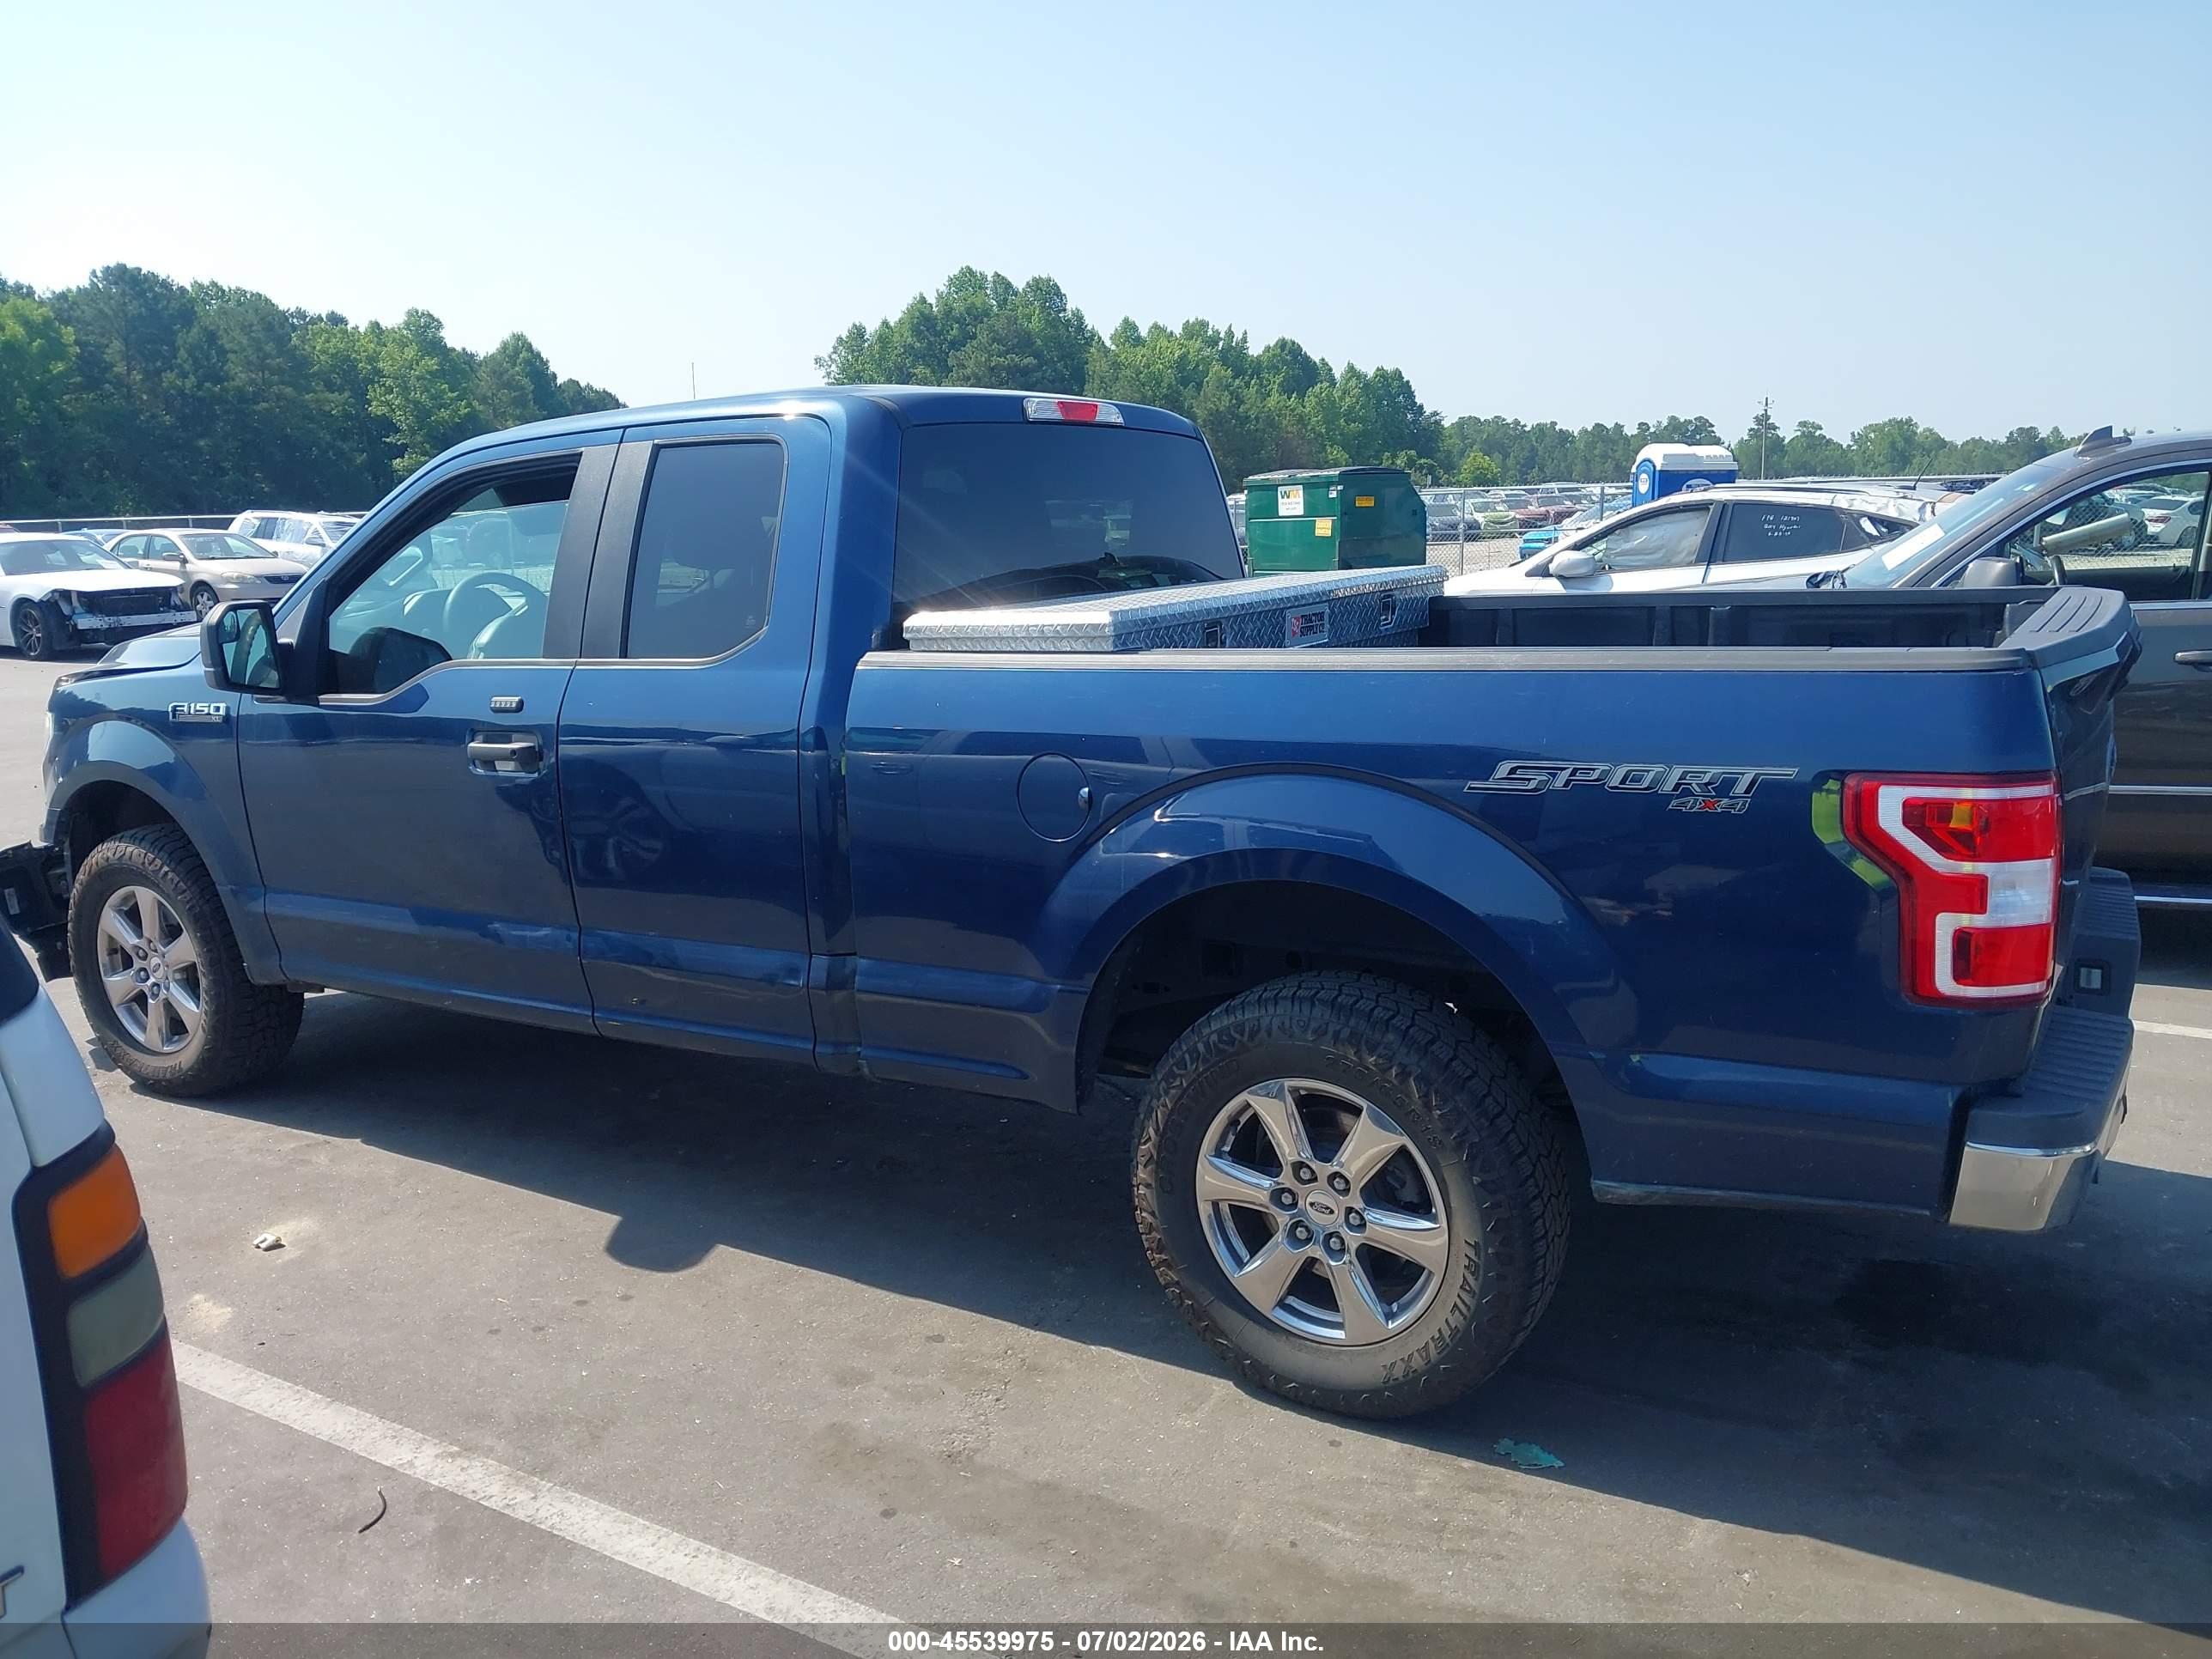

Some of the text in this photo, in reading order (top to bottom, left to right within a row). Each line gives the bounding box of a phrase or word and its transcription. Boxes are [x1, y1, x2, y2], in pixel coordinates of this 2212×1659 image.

[1279, 490, 1301, 500] WM
[1301, 611, 1326, 625] TRACTOR
[1300, 623, 1319, 637] SUPPLY
[1462, 760, 1800, 796] SPORT
[1381, 1238, 1478, 1384] TRAILTRAXX
